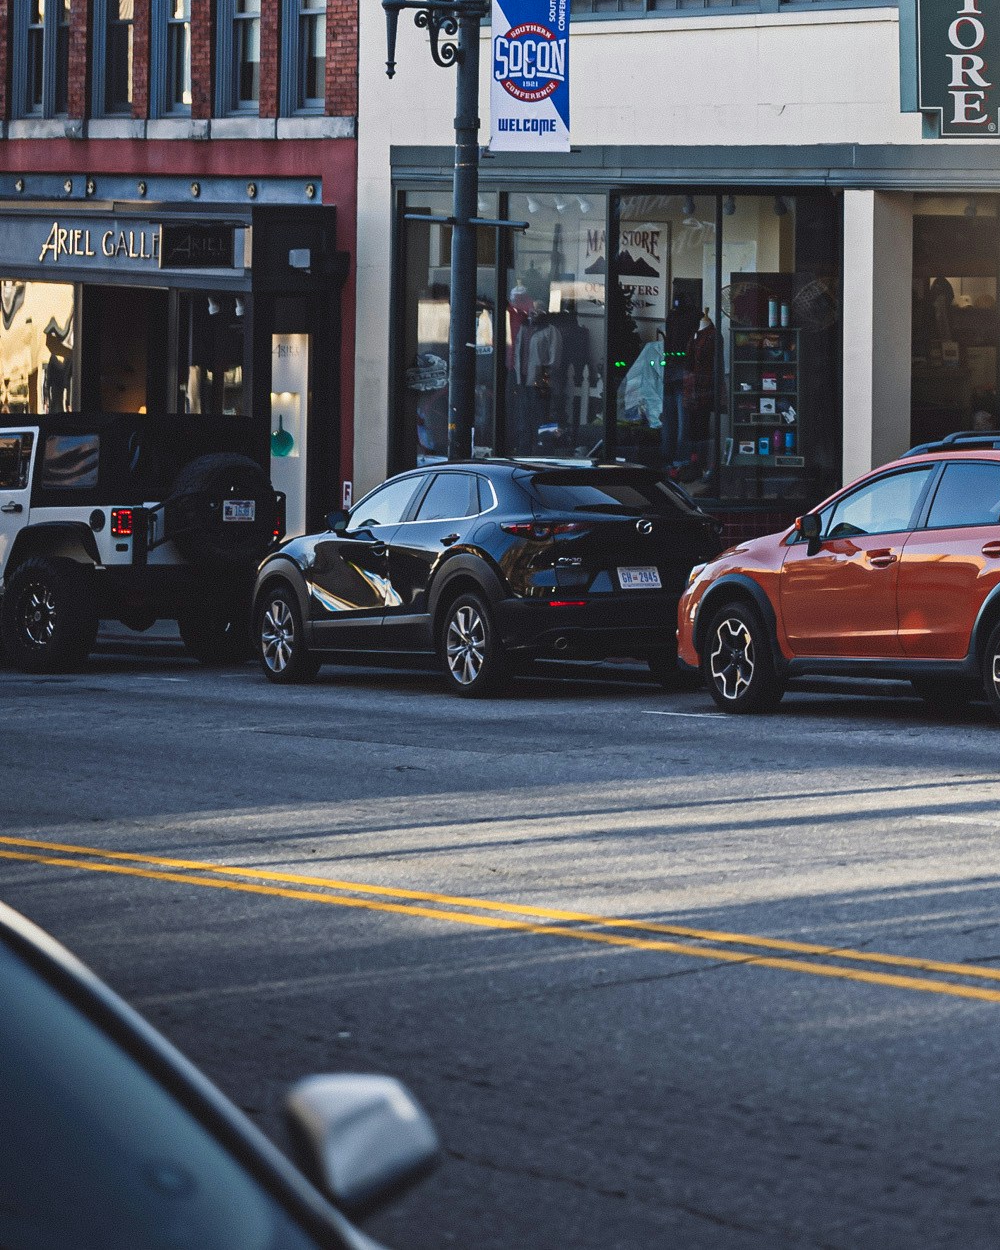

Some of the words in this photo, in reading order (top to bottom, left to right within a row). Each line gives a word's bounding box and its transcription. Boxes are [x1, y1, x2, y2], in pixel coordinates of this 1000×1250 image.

[510, 25, 552, 39] SOUTHERN
[495, 36, 566, 80] SOCON
[505, 81, 556, 99] CONFERENCE
[498, 118, 556, 135] WELCOME
[38, 222, 95, 262] ARIEL
[621, 230, 661, 263] STORE
